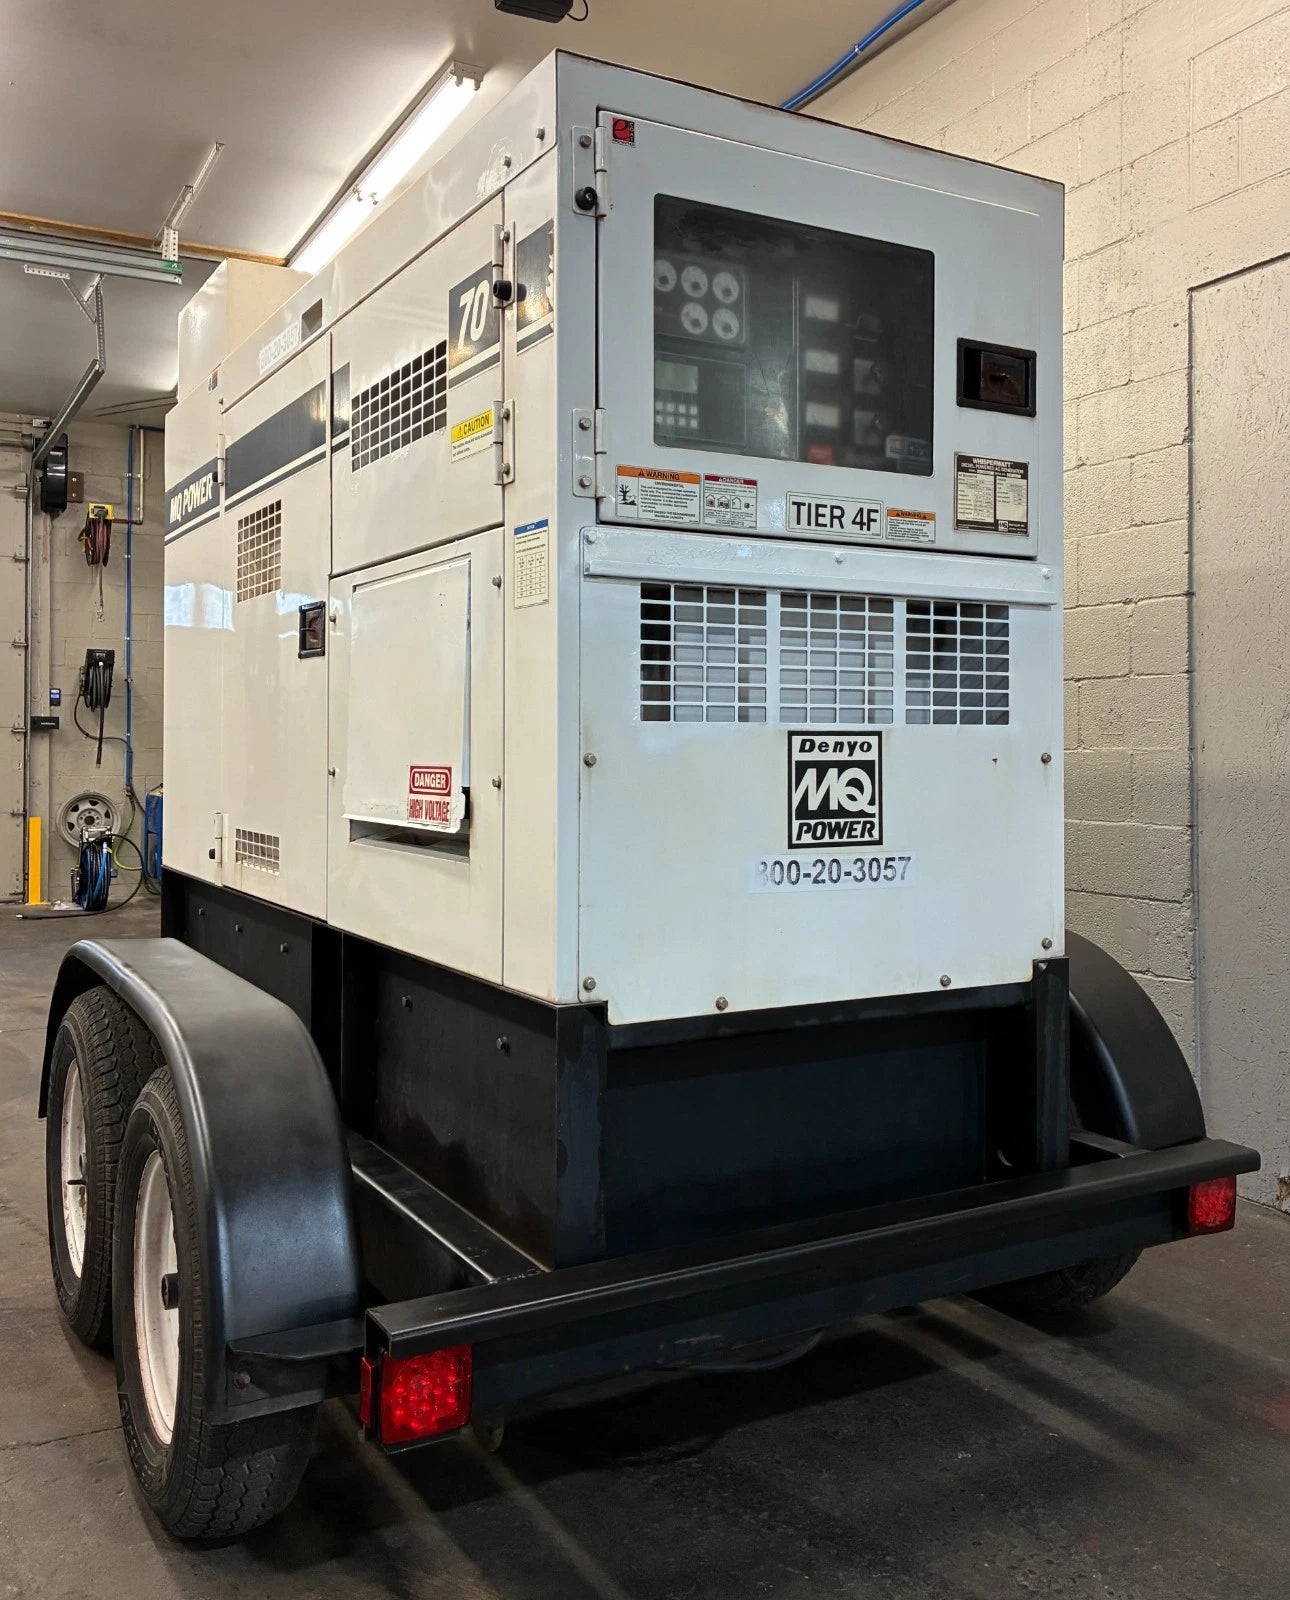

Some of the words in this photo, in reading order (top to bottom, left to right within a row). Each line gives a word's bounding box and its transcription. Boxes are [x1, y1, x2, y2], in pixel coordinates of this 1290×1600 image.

[457, 279, 490, 351] 70
[463, 413, 490, 435] CAUTION
[646, 470, 680, 481] WARNING
[170, 492, 182, 524] MQ
[182, 472, 213, 516] POWER
[791, 501, 845, 529] TIER
[851, 507, 879, 531] 4F
[798, 738, 873, 757] Denyo
[414, 773, 446, 789] DANGER
[792, 767, 876, 814] MQ
[408, 798, 424, 819] HIGH
[424, 799, 450, 823] VOLTAGE
[795, 820, 876, 841] POWER
